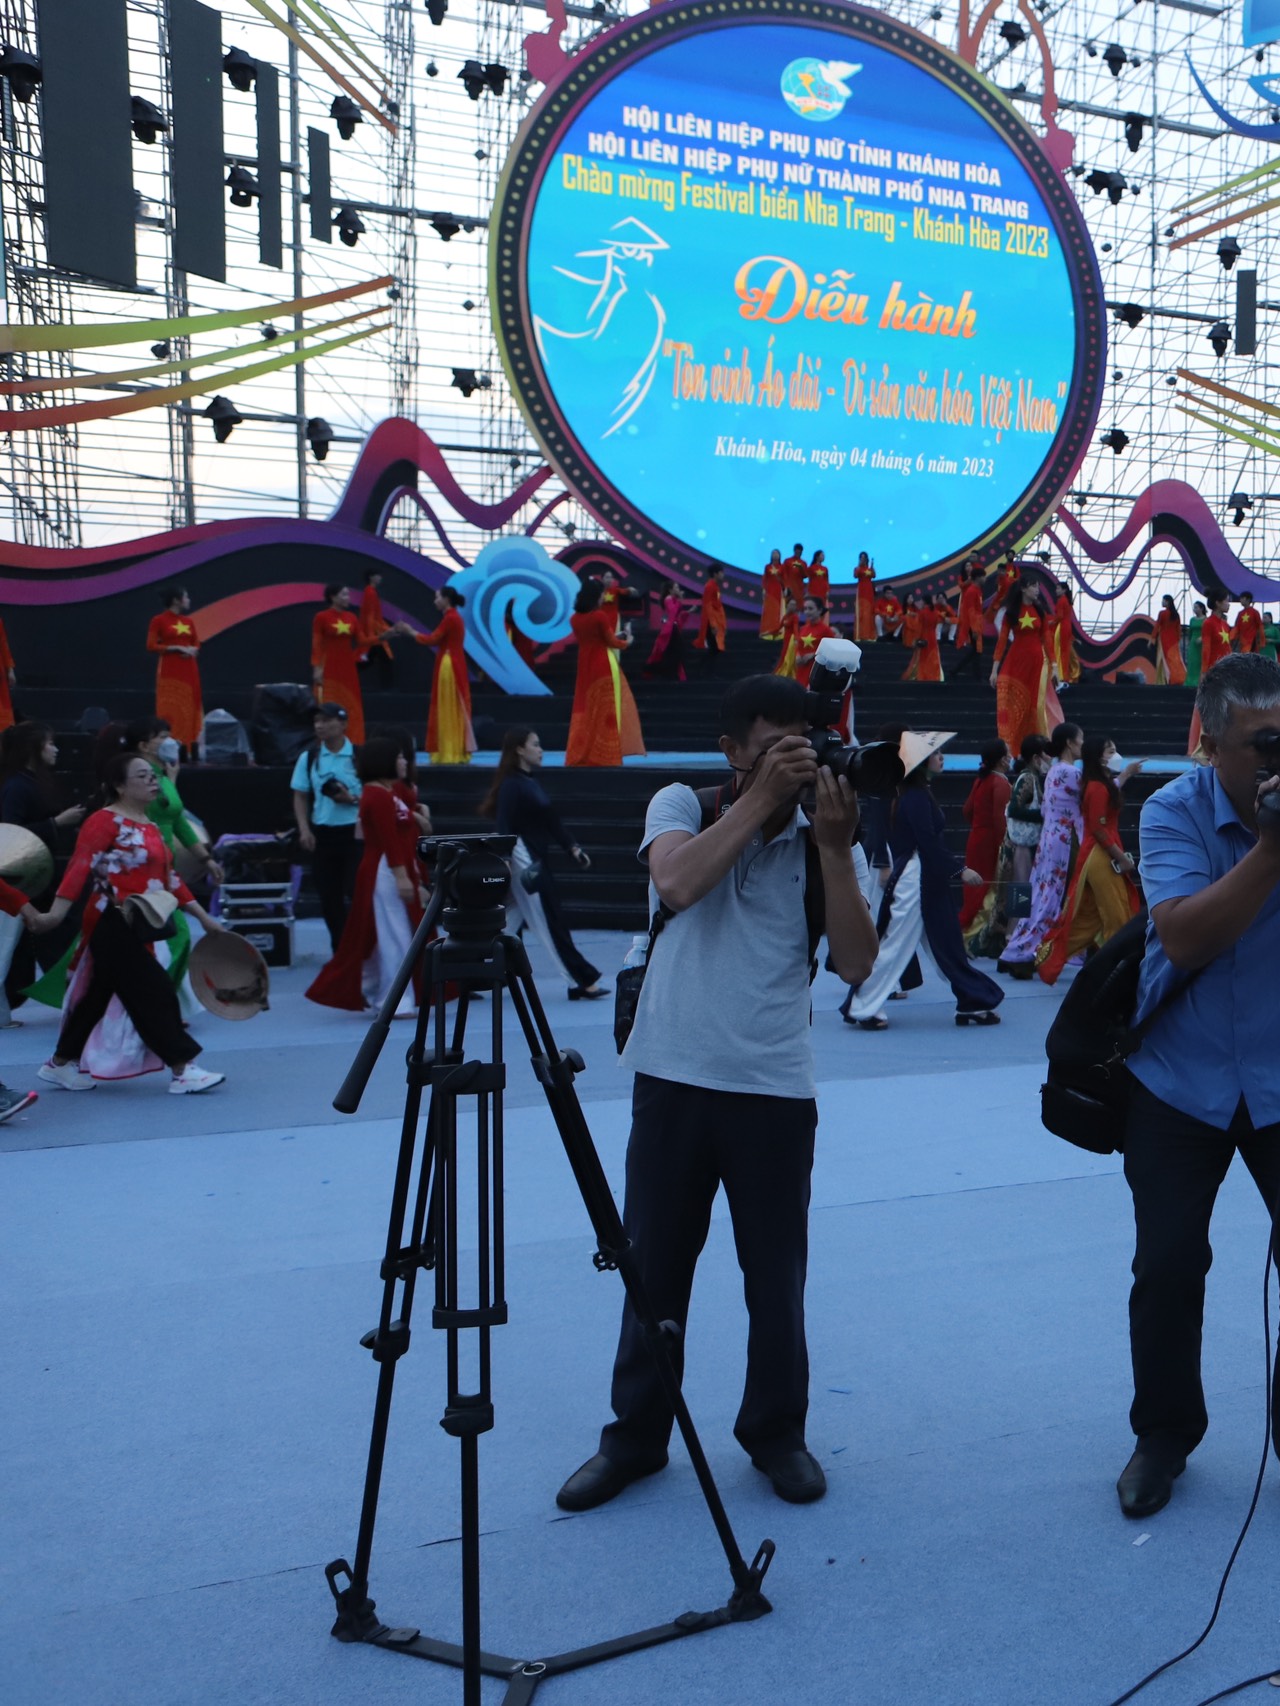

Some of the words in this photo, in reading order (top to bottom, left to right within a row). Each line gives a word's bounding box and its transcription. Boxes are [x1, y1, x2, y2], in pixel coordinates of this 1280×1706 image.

[588, 131, 625, 159] HỘI
[631, 138, 679, 165] LIÊN
[684, 147, 732, 174] HIỆP
[737, 155, 778, 184] PHỤ
[783, 162, 815, 185] NỮ
[817, 168, 881, 196] THÀNH
[885, 178, 924, 203] PHỐ
[928, 186, 967, 210] NHA
[971, 193, 1029, 219] TRANG
[623, 105, 660, 133] HỘI
[665, 112, 712, 139] LIÊN
[717, 121, 765, 149] HIỆP
[769, 129, 810, 159] PHỤ
[815, 136, 846, 160] NỮ
[848, 139, 892, 168] TỈNH
[897, 152, 960, 180] KHÁNH
[964, 162, 1002, 187] HÒA
[562, 153, 613, 195] Chào
[619, 169, 675, 212] mừng
[681, 171, 755, 215] Festival
[760, 184, 799, 221] biển
[804, 189, 838, 227] Nha
[843, 196, 895, 243] Trang
[913, 206, 965, 246] Khánh
[969, 215, 1001, 251] Hòa
[1005, 221, 1049, 258] 2023
[734, 255, 869, 325] Diễu
[878, 281, 977, 338] hành
[710, 346, 755, 406] vinh
[757, 334, 785, 409] Áo
[789, 352, 822, 412] dài
[869, 363, 901, 420] sản
[904, 369, 939, 423] văn
[940, 368, 975, 427] hóa
[980, 373, 1013, 444] Việt
[714, 435, 767, 459] Khánh
[770, 440, 807, 465] Hòa,
[811, 445, 847, 470] ngày
[850, 446, 867, 467] 04
[871, 448, 913, 476] tháng
[916, 452, 925, 471] 6
[928, 455, 958, 474] năm
[962, 457, 995, 477] 2023
